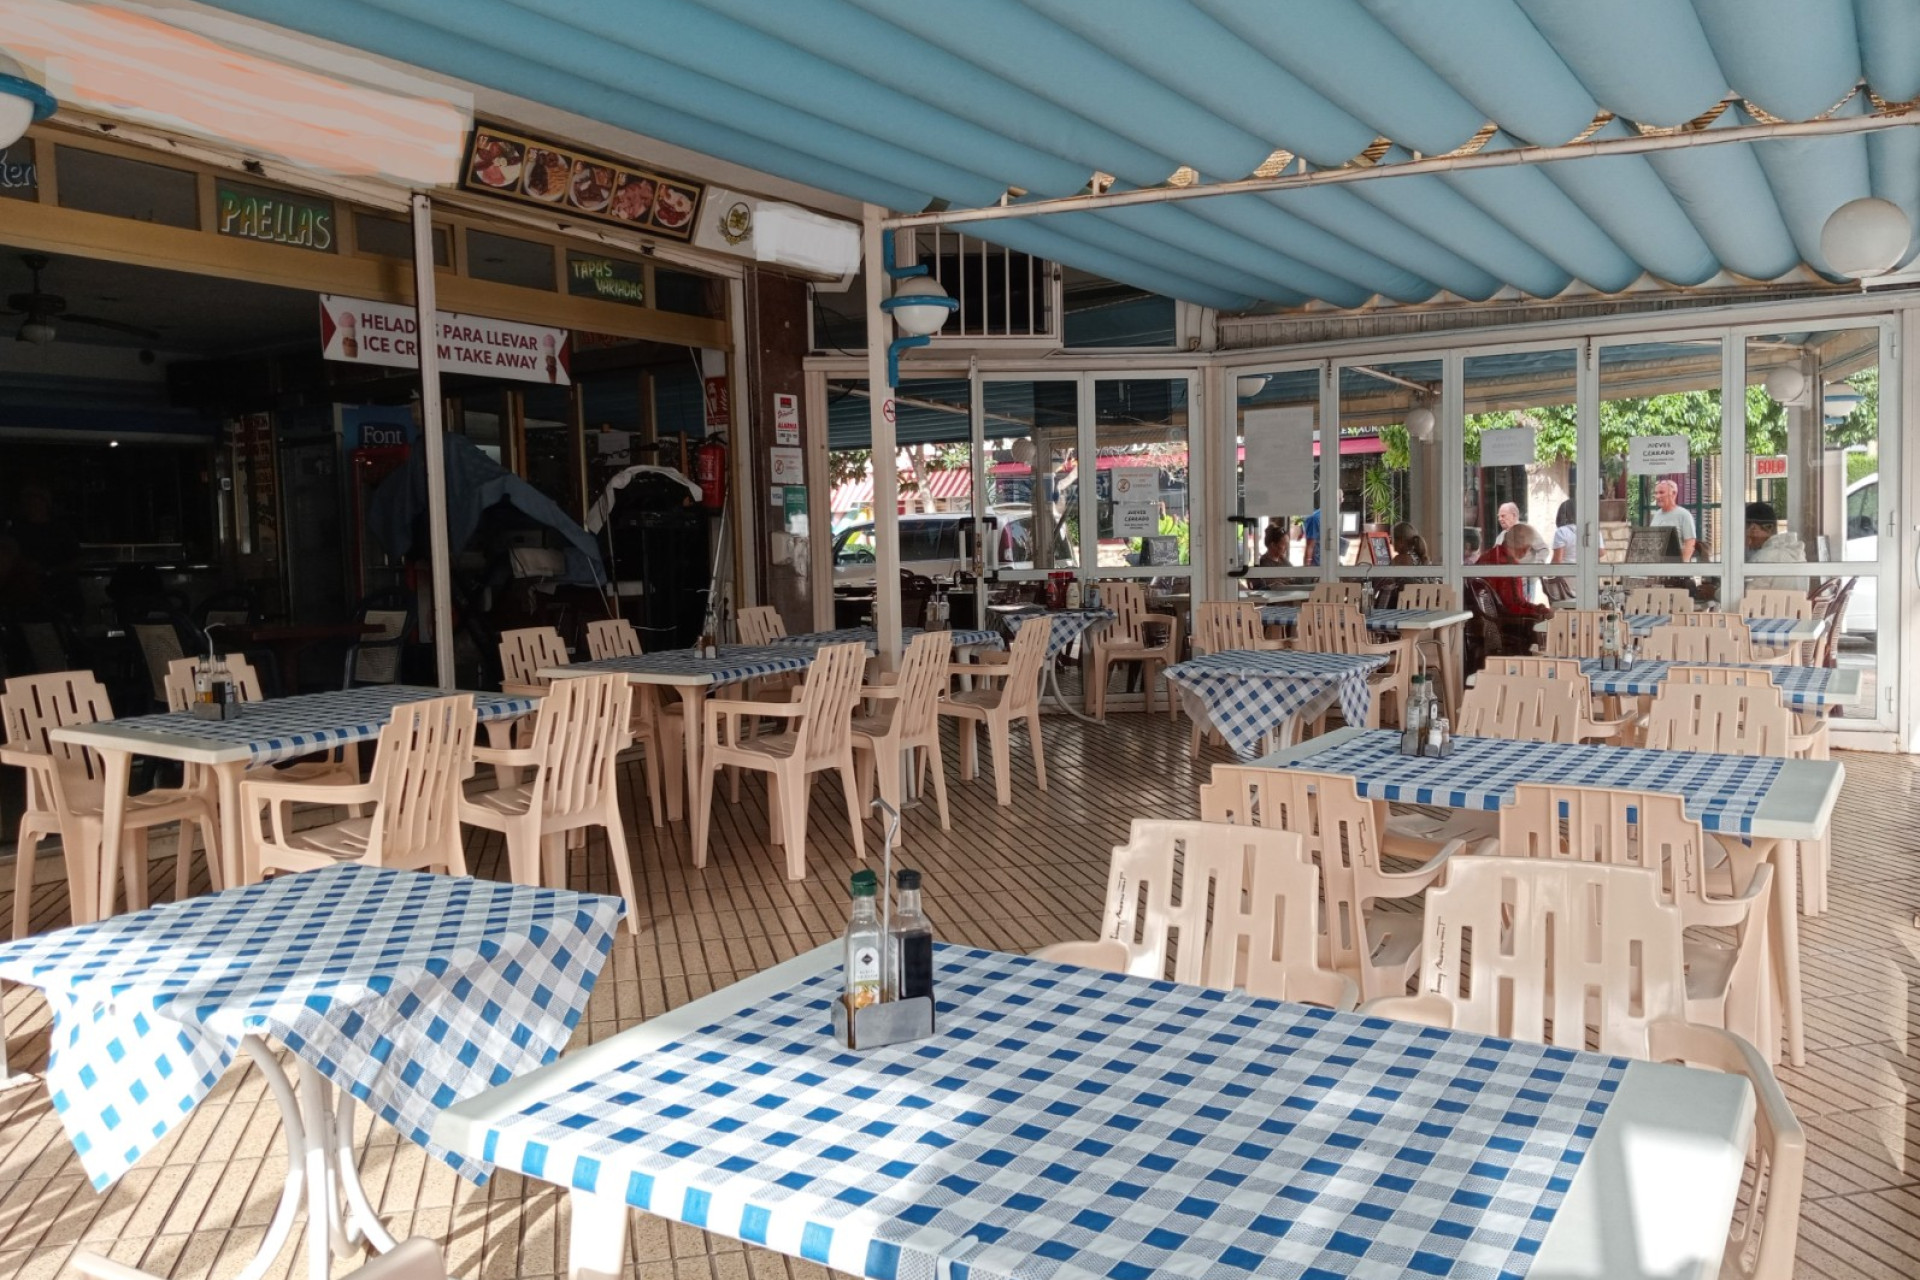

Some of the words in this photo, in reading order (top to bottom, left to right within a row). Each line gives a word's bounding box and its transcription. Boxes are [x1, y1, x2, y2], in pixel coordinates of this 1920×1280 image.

[220, 191, 331, 249] PAELLAS
[571, 260, 613, 279] TAPAS
[443, 325, 484, 343] PARA
[486, 330, 538, 350] LLEVAR
[363, 335, 390, 353] ICE
[394, 339, 452, 360] CRM
[454, 347, 492, 364] TAKE
[495, 353, 537, 370] AWAY
[363, 425, 403, 444] Font
